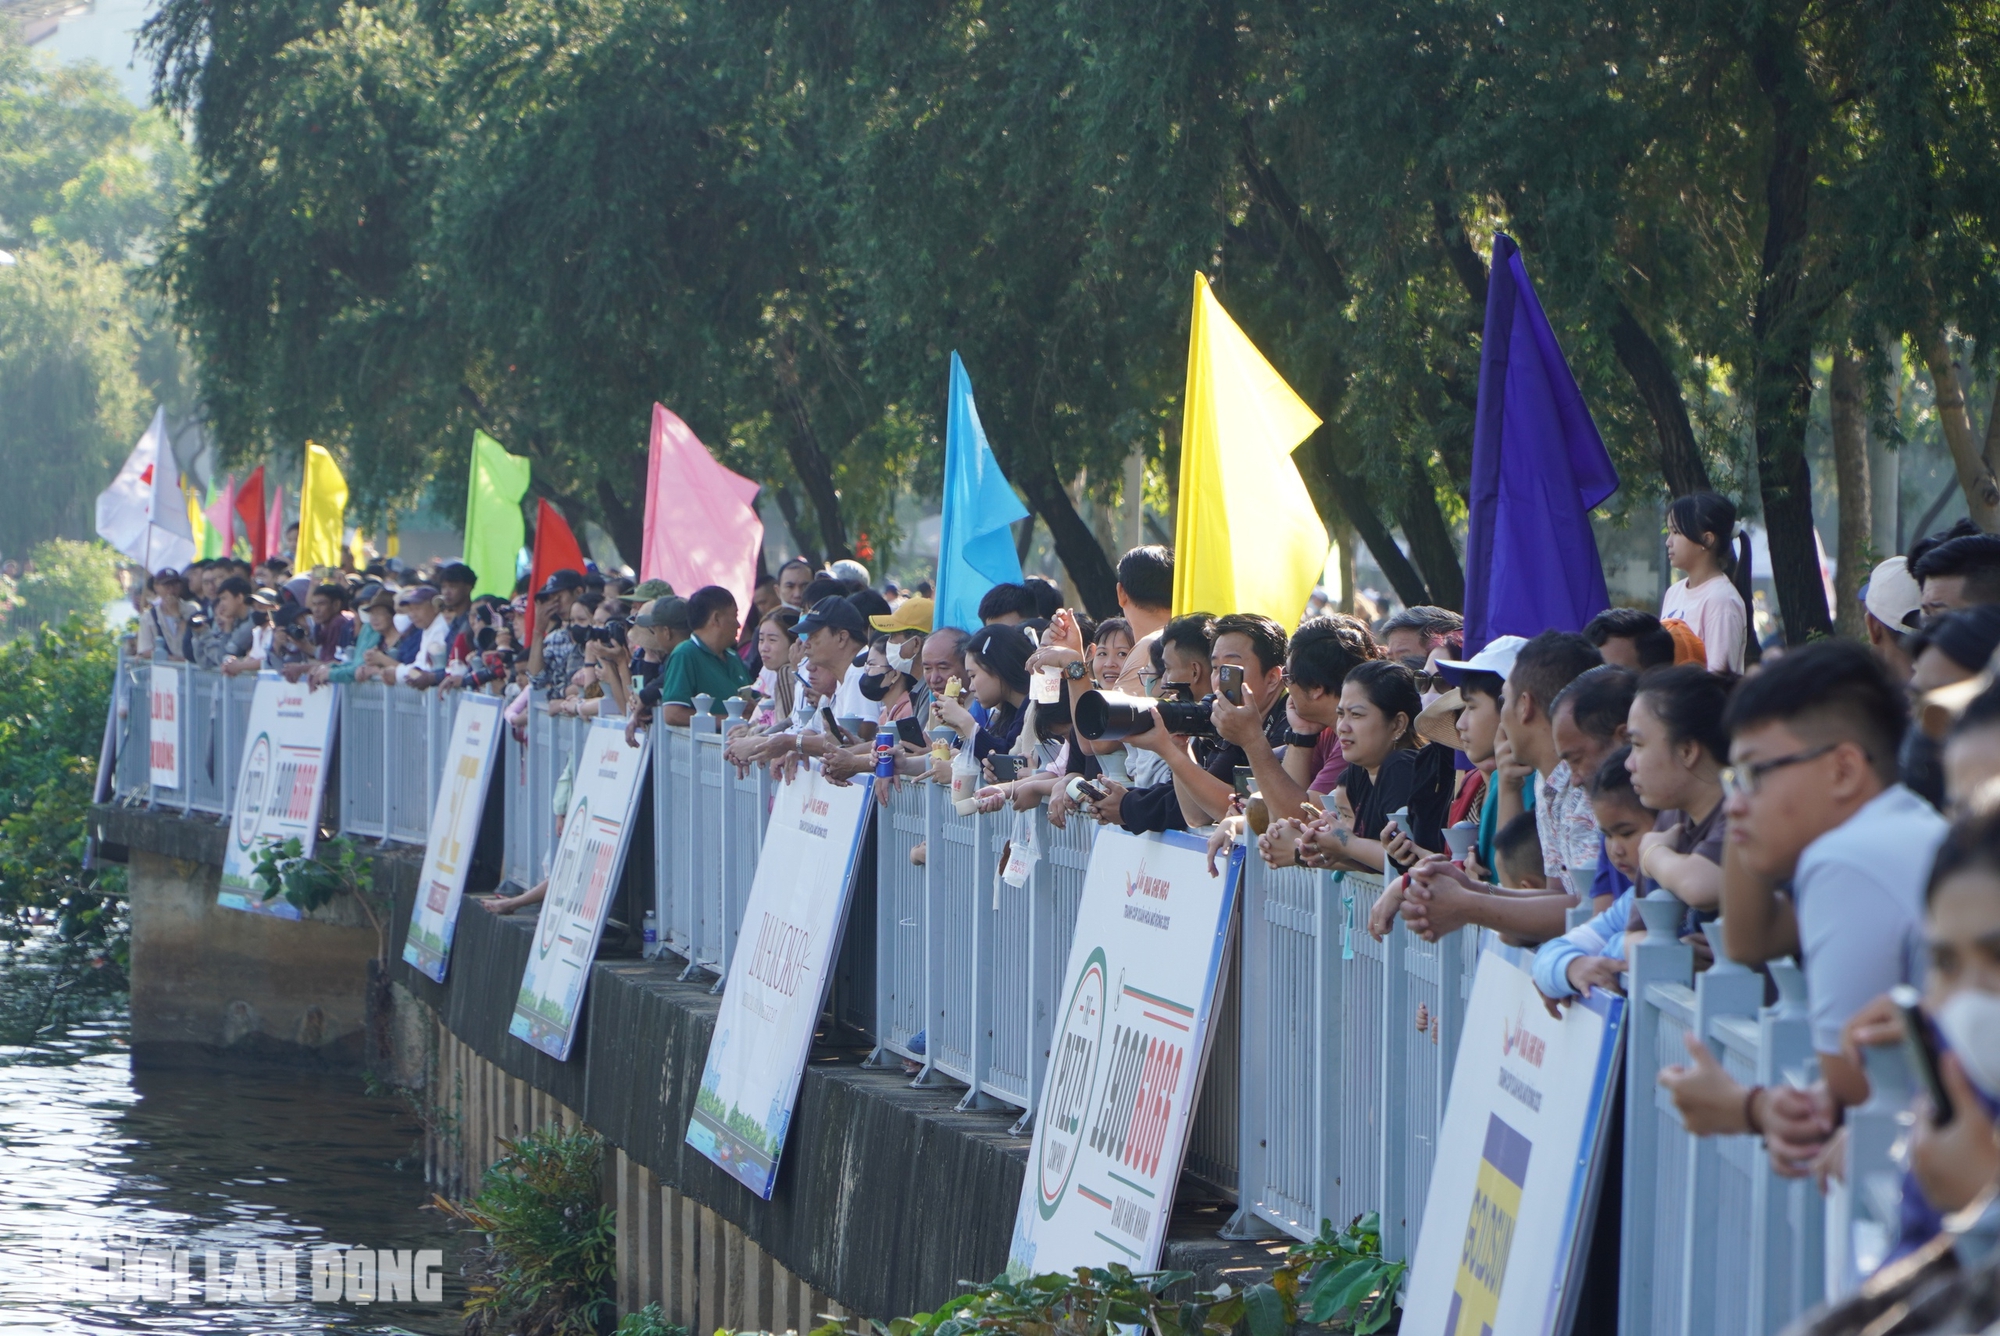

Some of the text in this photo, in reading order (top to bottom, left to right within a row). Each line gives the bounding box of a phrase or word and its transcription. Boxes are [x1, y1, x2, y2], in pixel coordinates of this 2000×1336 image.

[1050, 1032, 1093, 1135] PIZZA
[1089, 1024, 1183, 1180] 19006066
[1462, 1187, 1516, 1300] GOLDSUN
